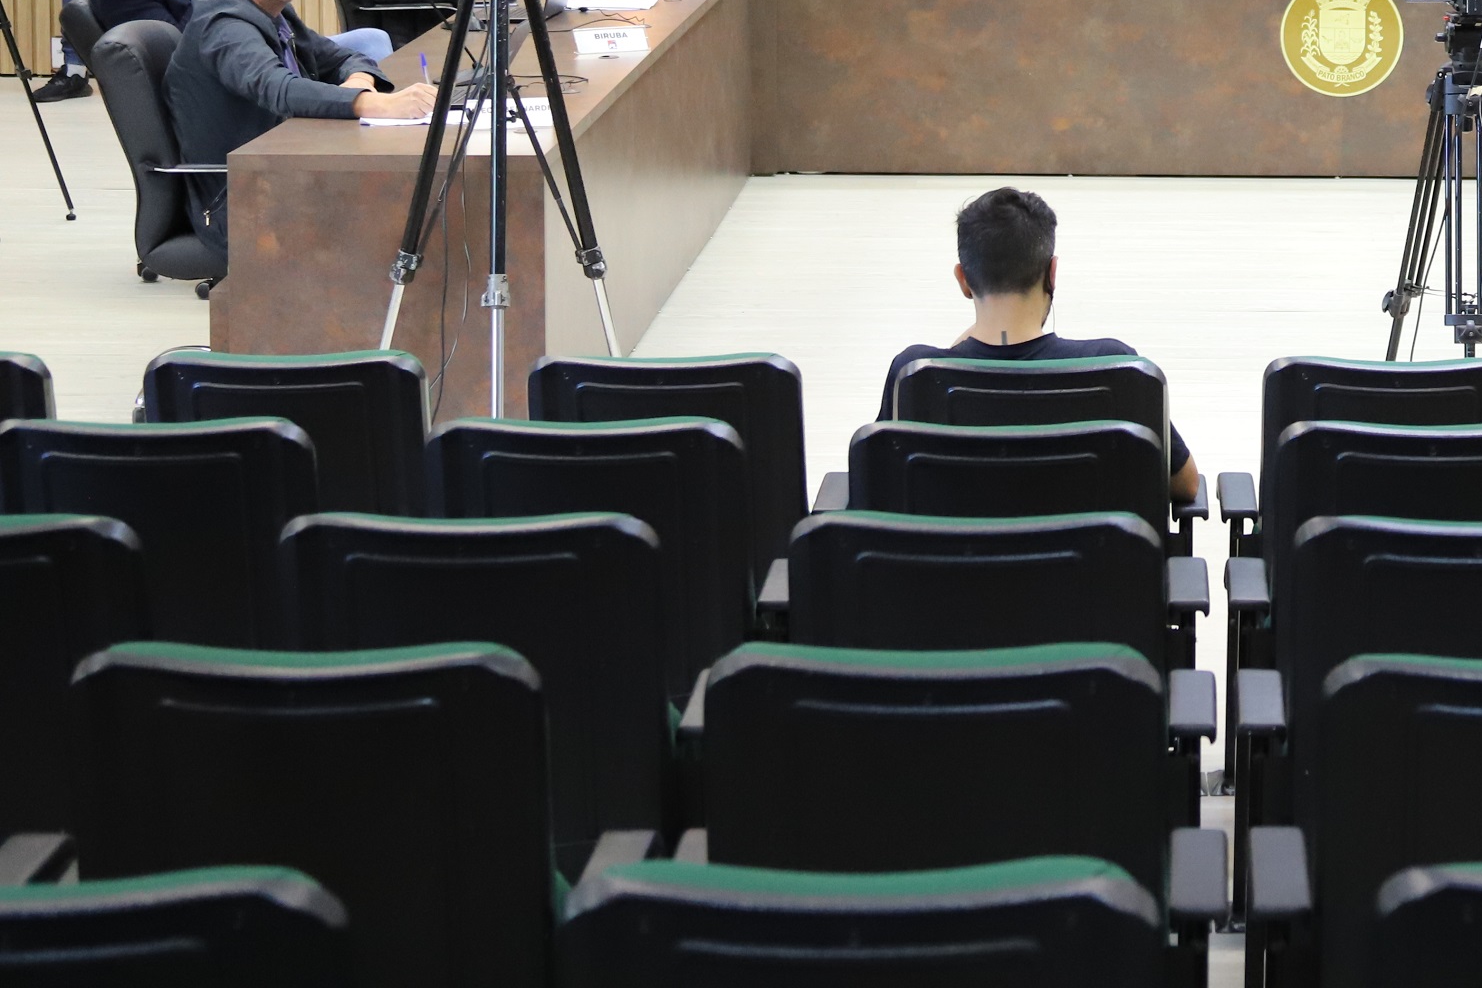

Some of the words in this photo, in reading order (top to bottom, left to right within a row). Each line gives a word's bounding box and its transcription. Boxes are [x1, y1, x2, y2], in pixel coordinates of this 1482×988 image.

[594, 32, 629, 40] BIRUBA
[1317, 69, 1336, 81] PATO
[1336, 70, 1366, 82] BRANCO
